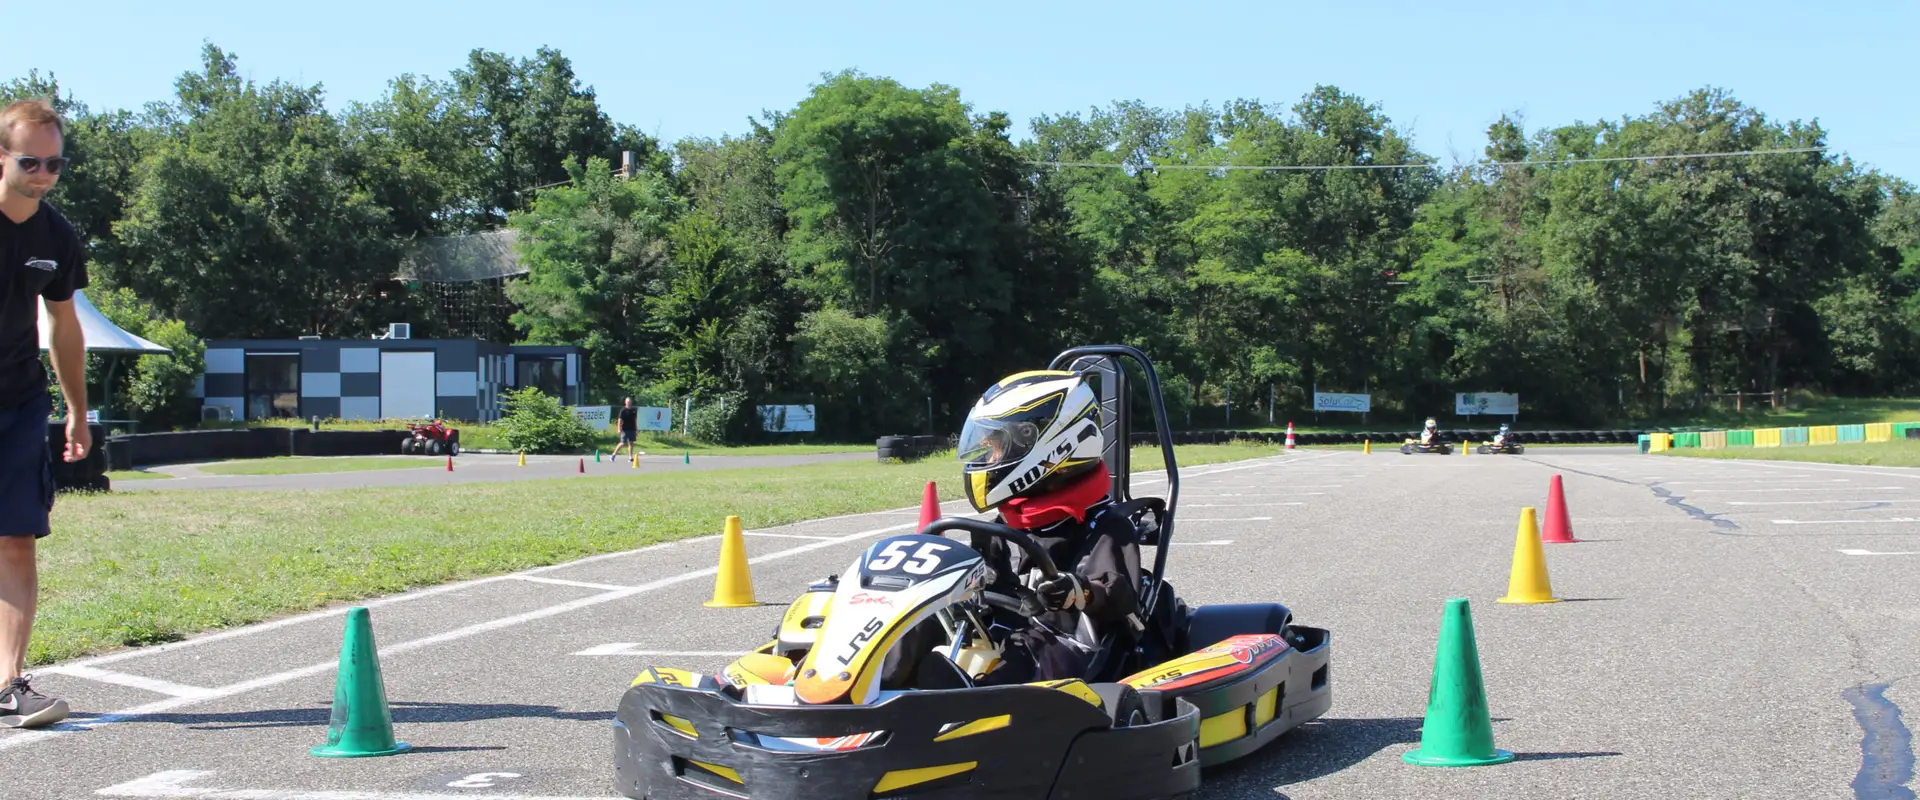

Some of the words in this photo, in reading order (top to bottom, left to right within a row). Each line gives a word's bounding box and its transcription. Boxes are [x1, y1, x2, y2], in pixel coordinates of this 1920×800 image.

[1008, 438, 1073, 495] BOX'S
[868, 541, 952, 575] 55
[837, 617, 884, 666] LRS
